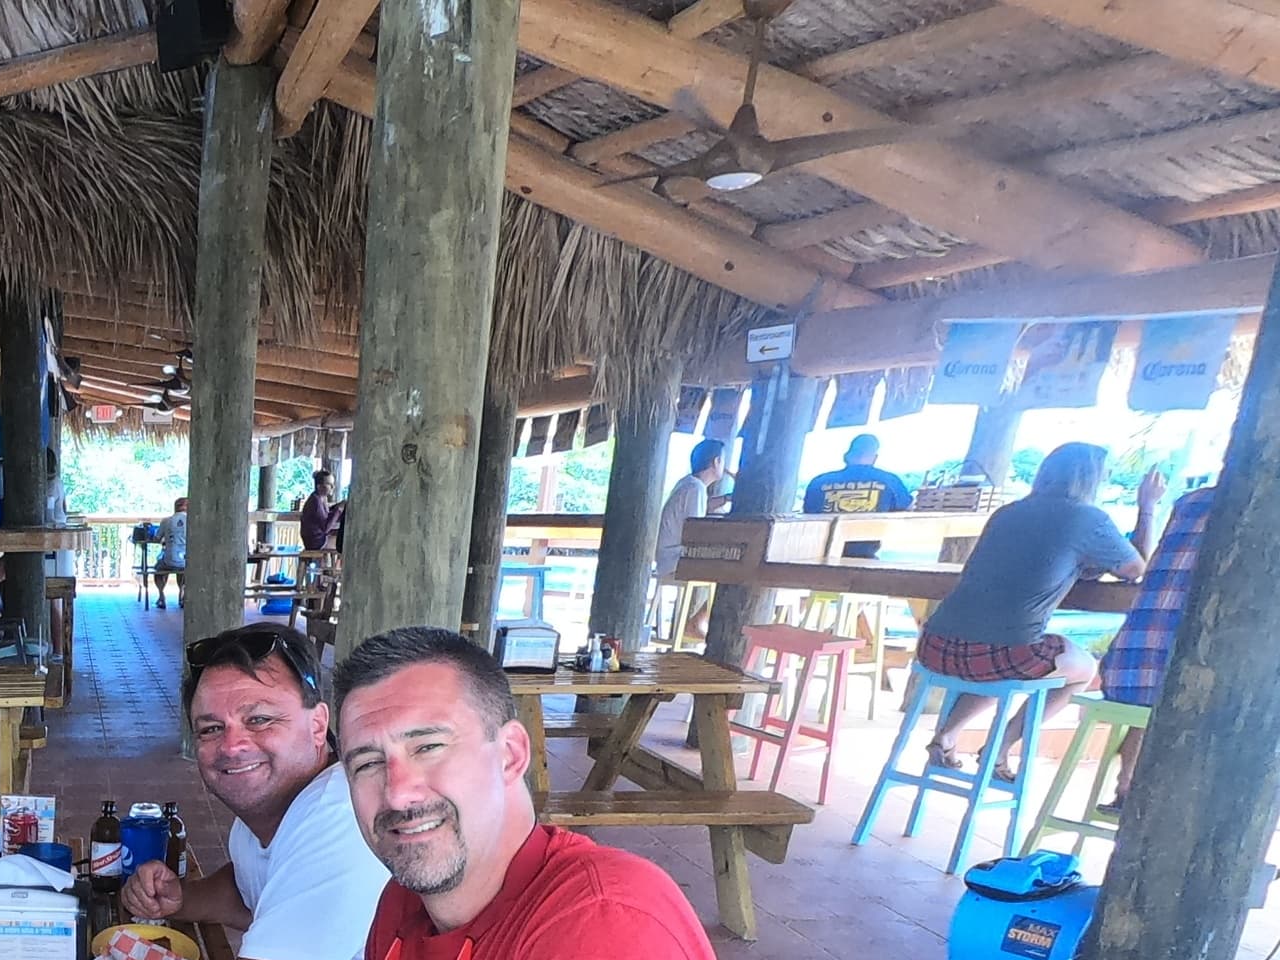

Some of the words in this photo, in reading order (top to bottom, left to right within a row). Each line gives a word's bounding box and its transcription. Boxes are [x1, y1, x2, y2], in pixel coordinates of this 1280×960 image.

[944, 360, 997, 377] Corona
[1143, 361, 1207, 381] Corona
[1007, 928, 1053, 948] STORM
